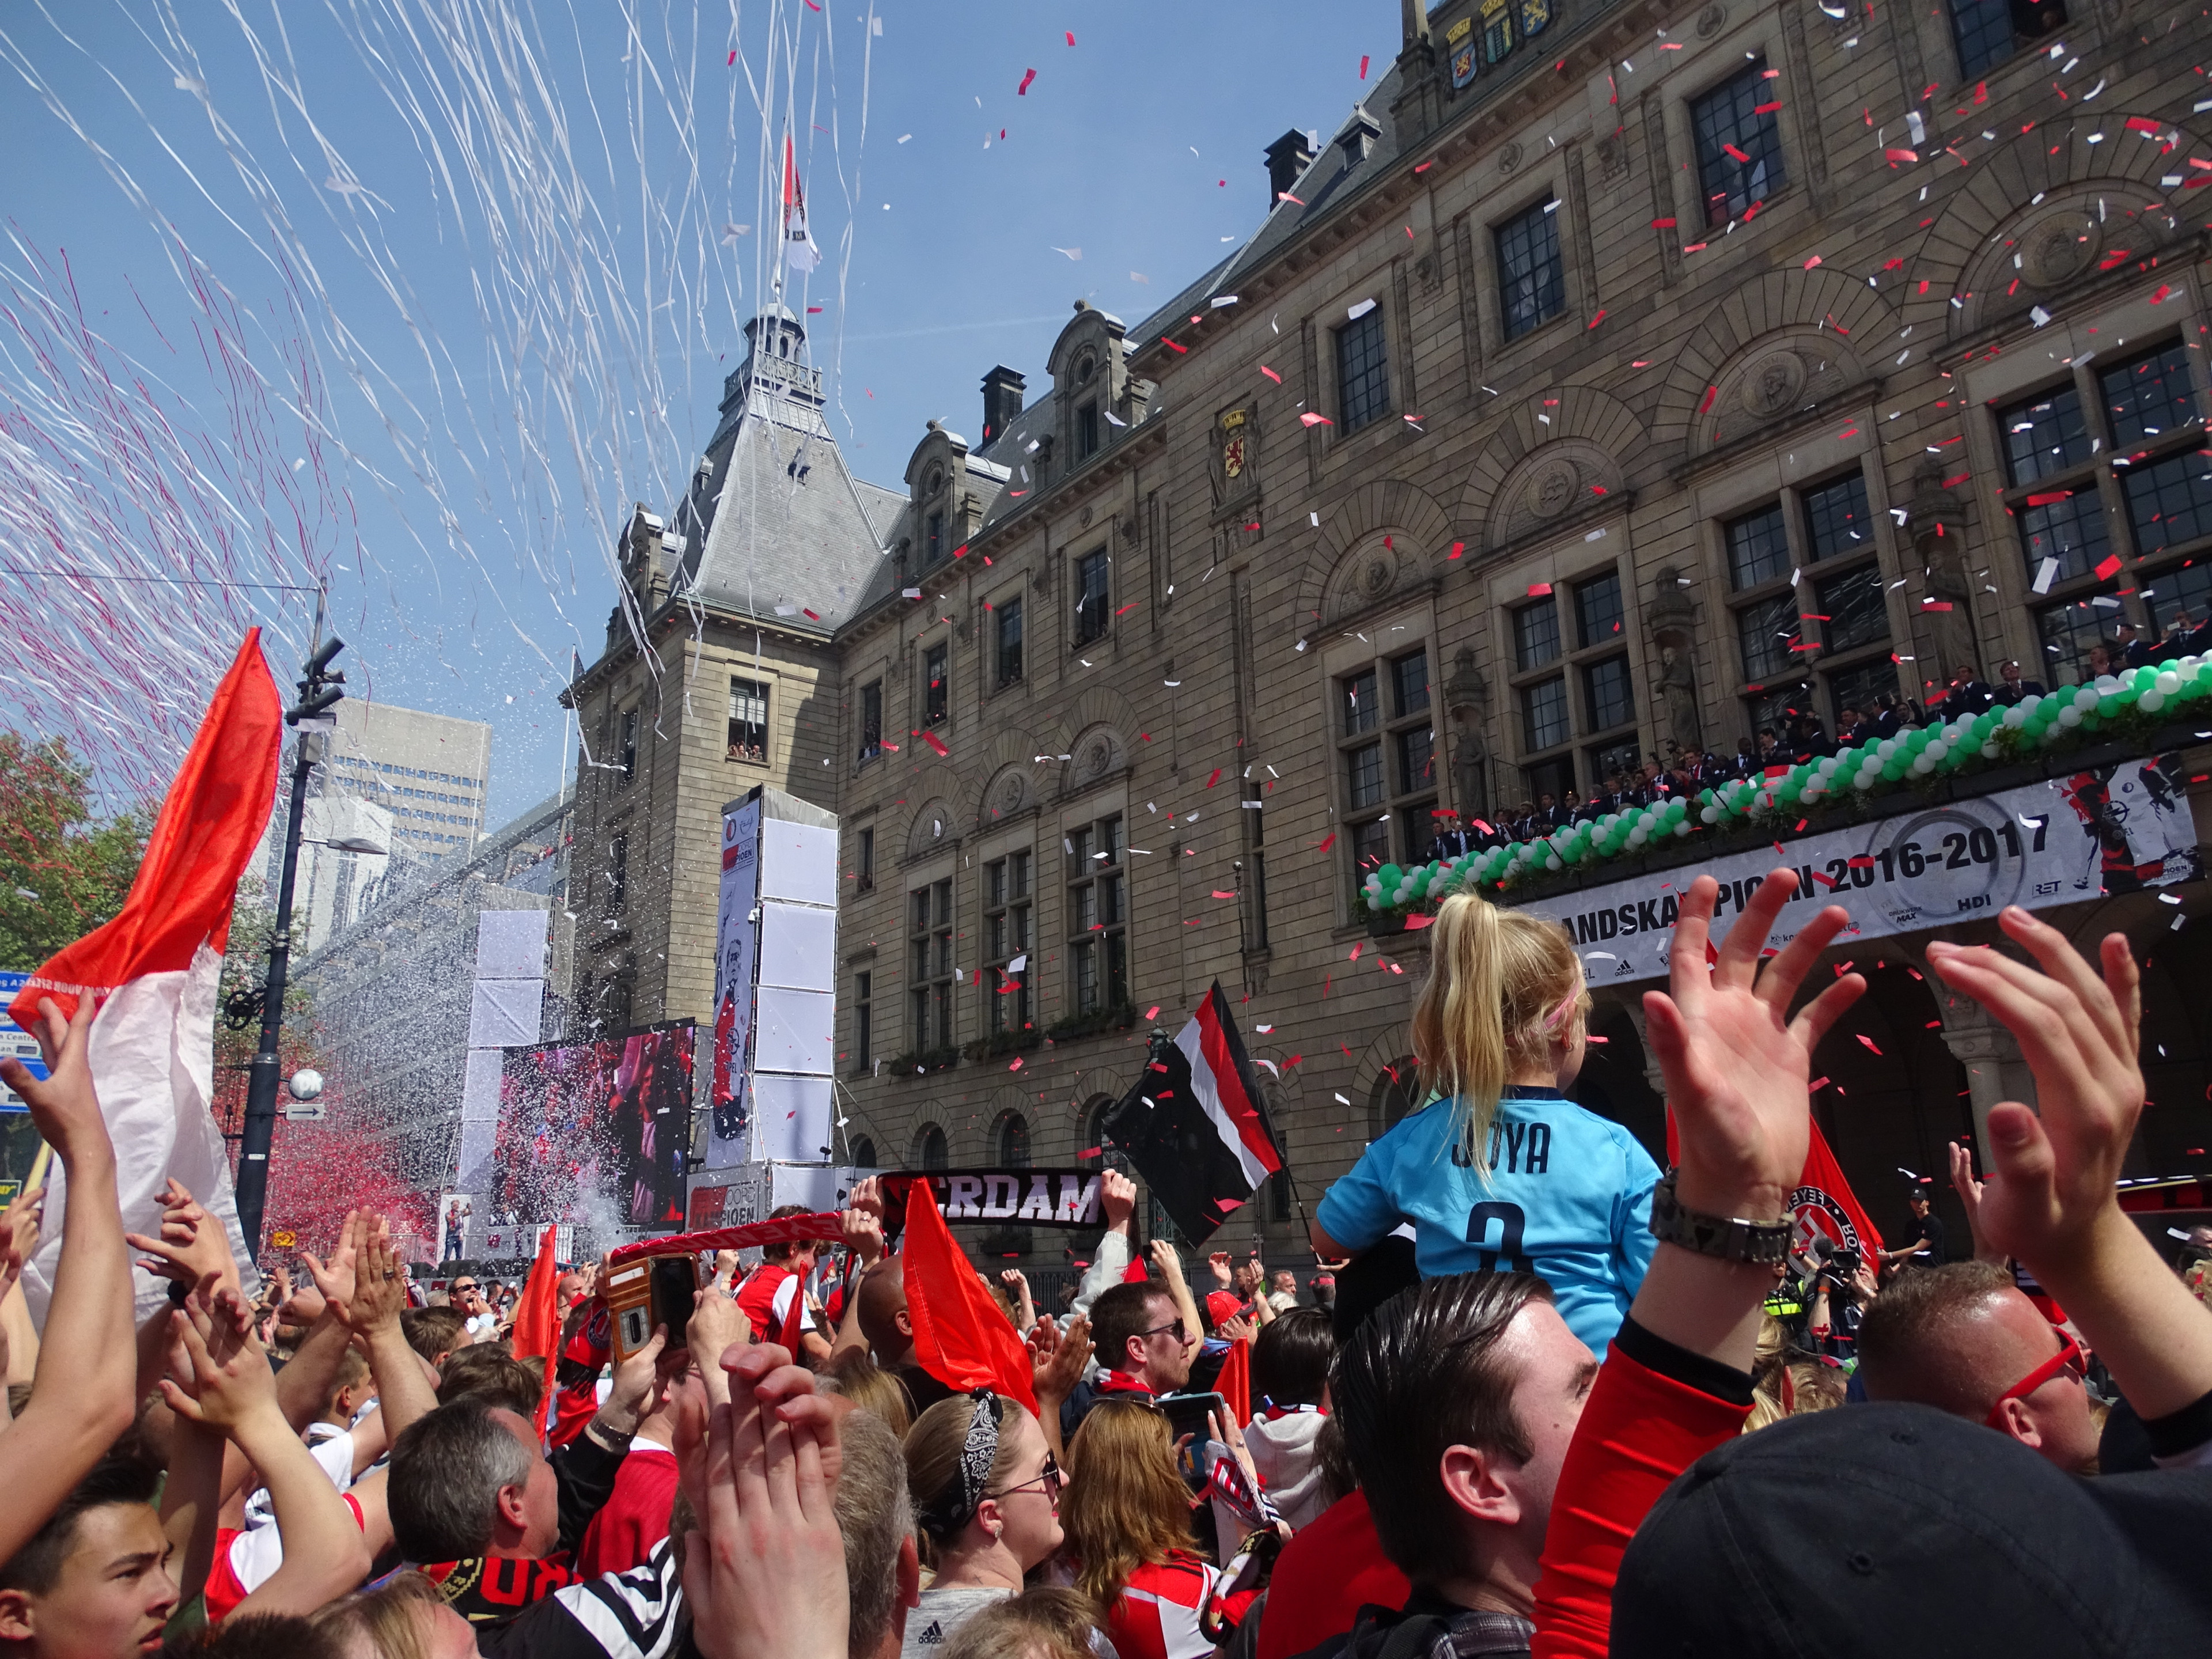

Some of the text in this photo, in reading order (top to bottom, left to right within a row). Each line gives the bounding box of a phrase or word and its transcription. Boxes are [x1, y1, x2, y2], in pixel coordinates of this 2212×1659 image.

[1825, 813, 2049, 894] 2016-2017
[2035, 880, 2062, 895] RET
[1957, 893, 1991, 911] HDI
[1896, 912, 1916, 923] MAX
[1615, 968, 1635, 977] adidas
[1451, 1119, 1551, 1173] JOYA
